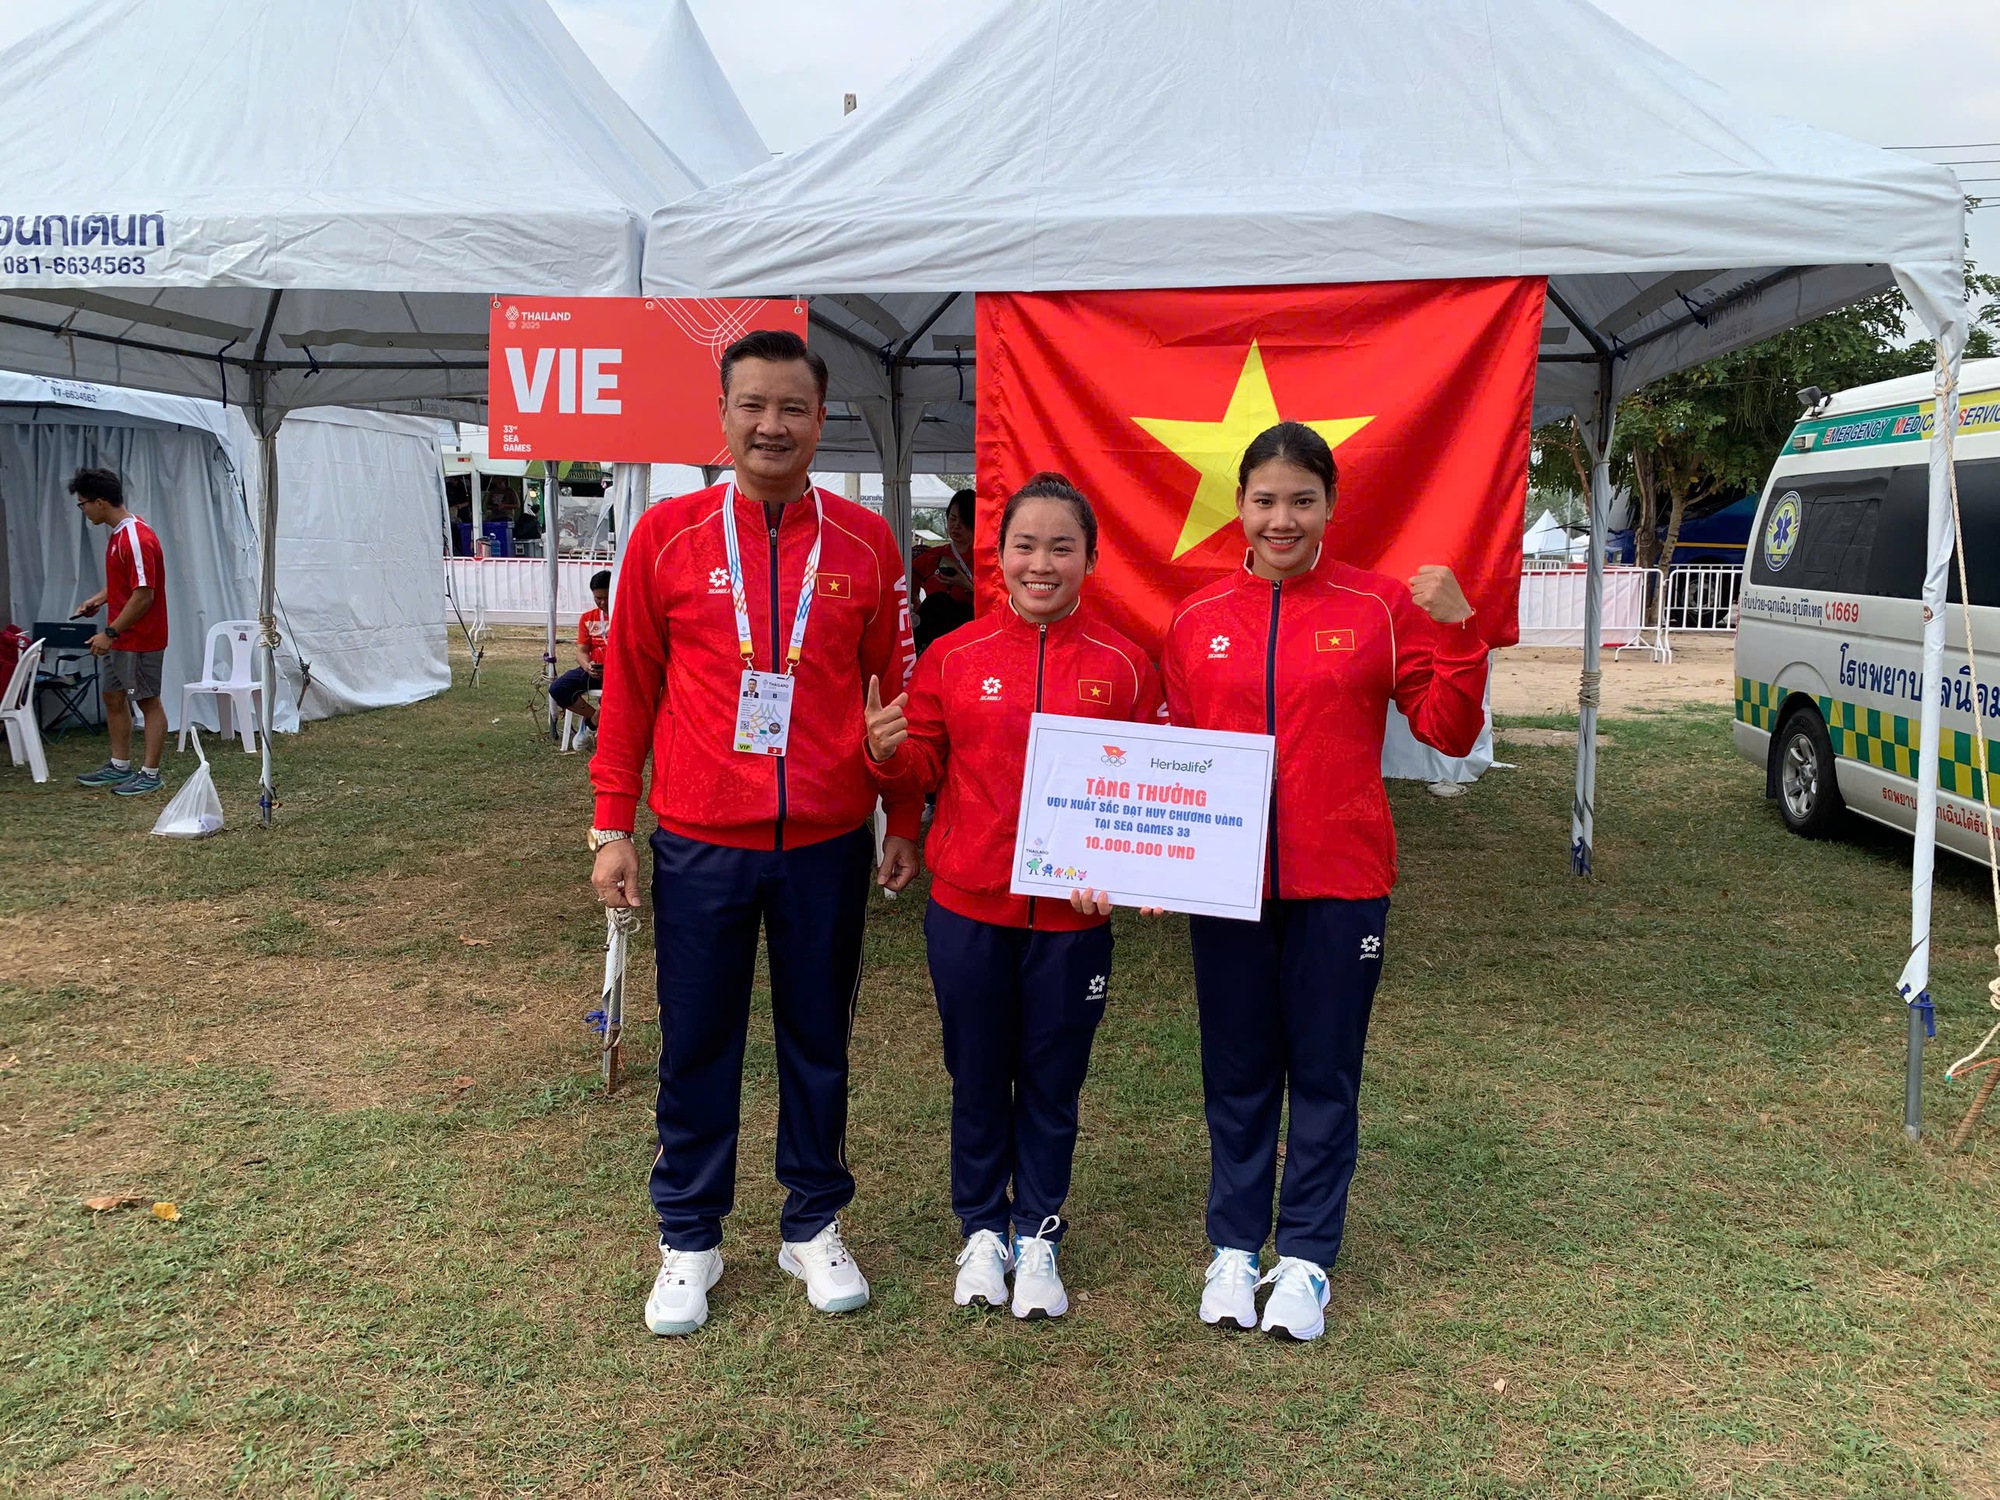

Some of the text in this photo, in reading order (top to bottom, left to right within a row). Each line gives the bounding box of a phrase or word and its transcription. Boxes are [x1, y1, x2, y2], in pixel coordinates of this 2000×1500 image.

[4, 256, 145, 275] 081-6634563
[521, 312, 571, 321] THAILAND
[521, 321, 540, 329] 2025
[504, 348, 622, 415] VIE
[503, 435, 519, 443] SEA
[1822, 419, 1890, 445] EMERGENCY
[1892, 413, 1935, 436] MEDIC
[503, 444, 532, 452] GAMES
[1831, 601, 1859, 623] 1669
[1150, 757, 1207, 774] Herbalife
[1086, 776, 1207, 808] TẶNG THƯỞNG
[1070, 797, 1097, 812] XUẤT
[1099, 801, 1119, 814] SẮC
[1123, 804, 1143, 818] ĐẠT
[1145, 807, 1166, 819] HUY
[1169, 809, 1211, 825] CHƯƠNG
[1215, 813, 1243, 828] VÀNG
[1095, 818, 1190, 838] TẠI SEA GAMES 33
[1085, 835, 1196, 860] 10.000.000 VND
